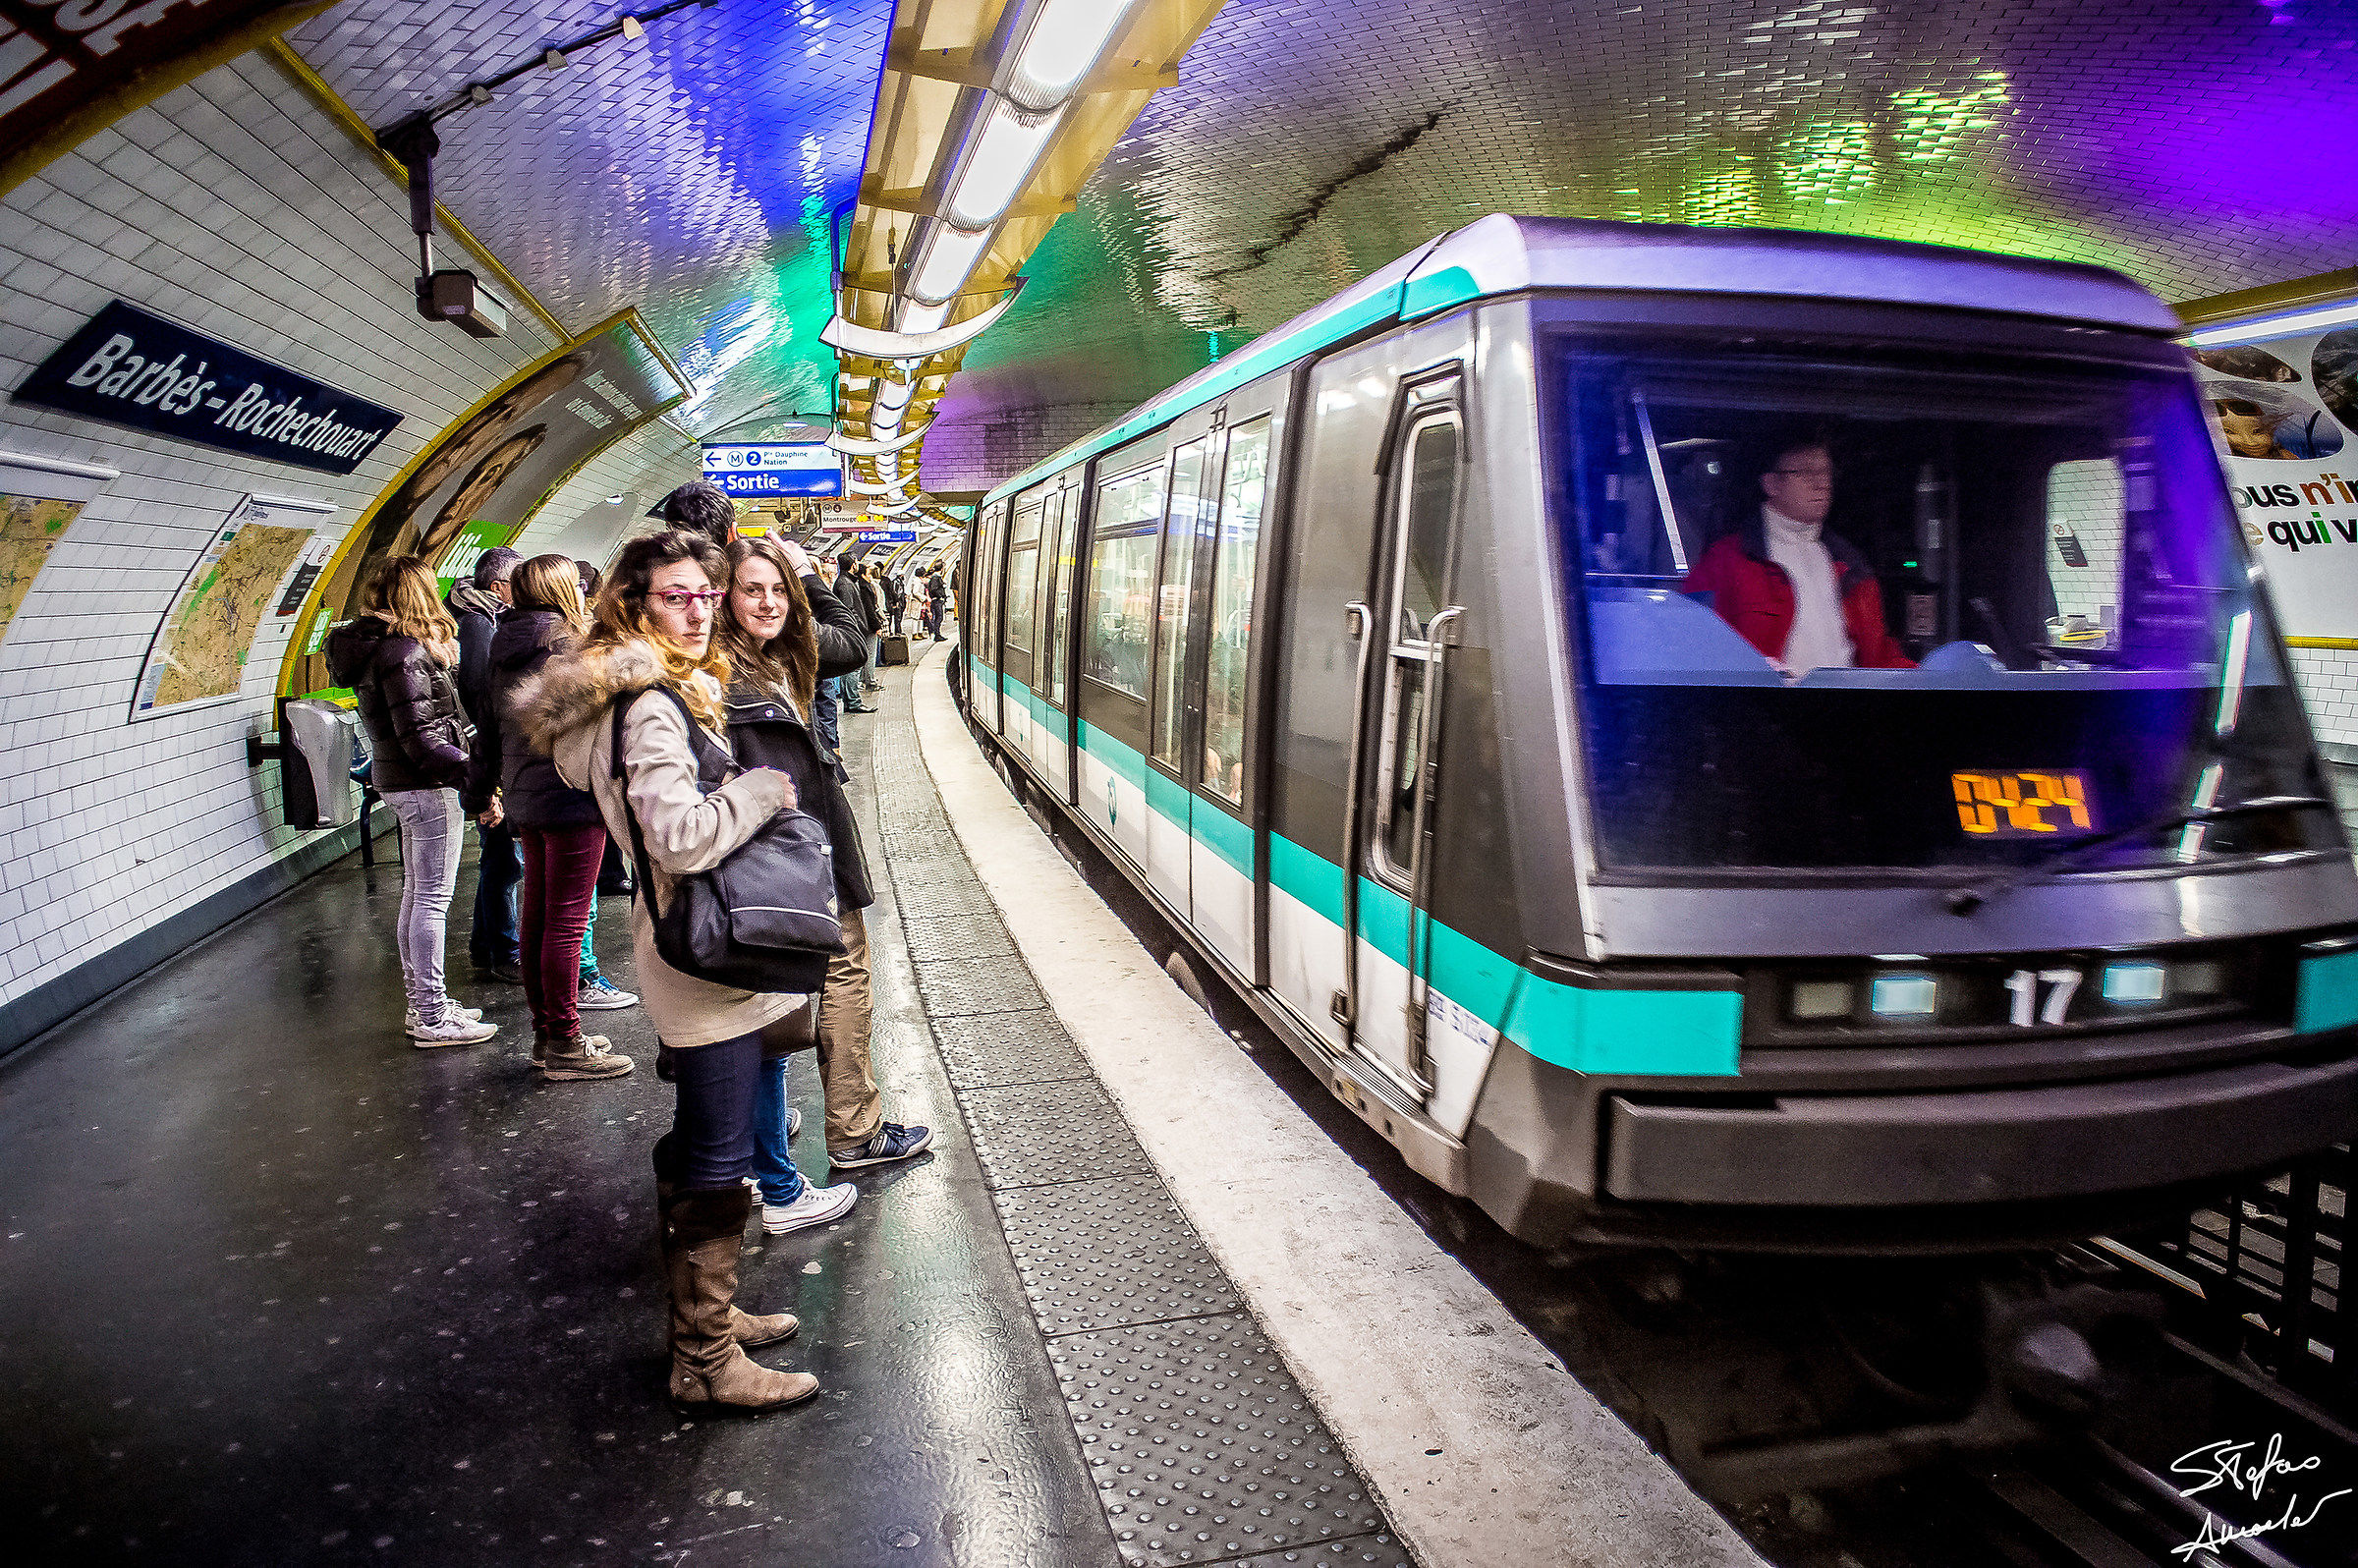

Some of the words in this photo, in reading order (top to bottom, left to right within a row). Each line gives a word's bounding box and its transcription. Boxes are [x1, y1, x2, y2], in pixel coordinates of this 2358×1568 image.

[726, 473, 781, 491] Sortie
[868, 532, 891, 540] Sortie
[2267, 511, 2332, 552] qui
[2003, 969, 2083, 1028] 17
